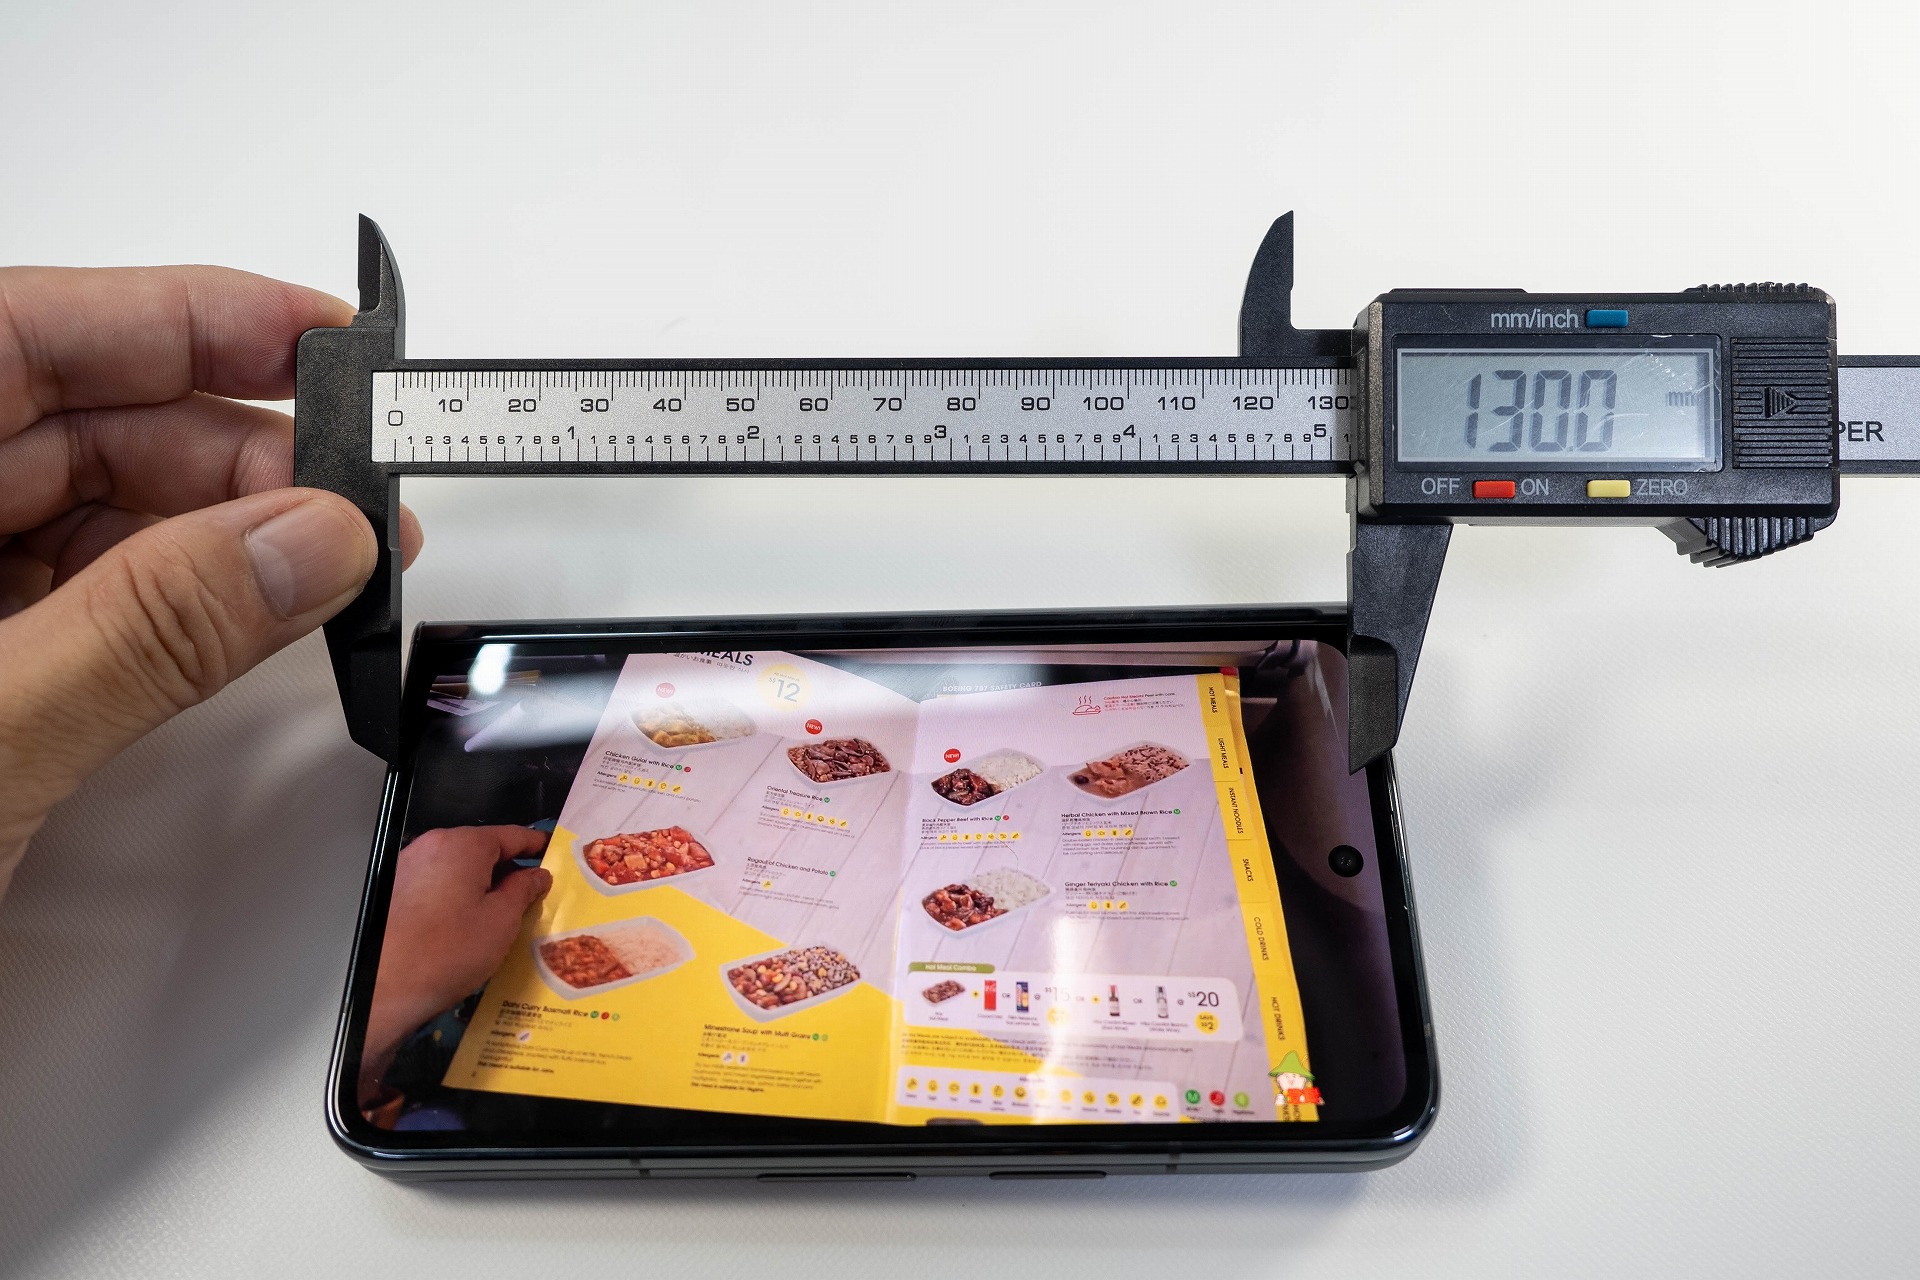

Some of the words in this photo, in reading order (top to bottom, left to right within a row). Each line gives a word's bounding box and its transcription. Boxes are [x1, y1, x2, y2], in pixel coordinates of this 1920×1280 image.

[1490, 308, 1579, 329] mm/inch
[438, 398, 463, 413] 10
[508, 398, 537, 413] 20
[581, 398, 609, 413] 30
[653, 398, 682, 412] 40
[726, 398, 755, 412] 50
[800, 398, 828, 412] 60
[873, 398, 902, 412] 70
[947, 397, 976, 412] 80
[1021, 397, 1050, 412] 90
[1083, 396, 1124, 411] 100
[1158, 396, 1195, 411] 110
[1233, 396, 1273, 411] 120
[1308, 396, 1349, 411] 130
[407, 435, 413, 445] 1
[424, 435, 434, 445] 2
[442, 435, 452, 445] 3
[460, 435, 470, 445] 4
[479, 435, 488, 445] 5
[497, 435, 506, 445] 6
[514, 435, 523, 445] 7
[532, 435, 542, 445] 8
[551, 435, 560, 445] 9
[567, 425, 575, 440] 1
[590, 435, 596, 445] 1
[608, 435, 617, 445] 2
[626, 435, 635, 445] 3
[644, 434, 654, 445] 4
[663, 434, 672, 445] 5
[681, 434, 690, 445] 6
[699, 434, 708, 445] 7
[717, 434, 727, 445] 8
[736, 434, 746, 445] 9
[746, 425, 760, 440] 2
[776, 434, 782, 444] 1
[794, 434, 803, 444] 2
[812, 434, 821, 444] 3
[830, 434, 840, 444] 4
[849, 434, 859, 444] 5
[867, 434, 877, 444] 6
[885, 434, 895, 444] 7
[904, 434, 914, 444] 8
[923, 434, 933, 444] 9
[933, 424, 947, 440] 3
[963, 434, 969, 444] 1
[981, 434, 991, 444] 2
[1000, 434, 1009, 444] 3
[1018, 433, 1028, 444] 4
[1037, 433, 1047, 444] 5
[1056, 433, 1065, 444] 6
[1074, 433, 1083, 444] 7
[1093, 433, 1102, 444] 8
[1112, 433, 1122, 444] 9
[1122, 424, 1137, 439] 4
[1152, 433, 1159, 444] 1
[1171, 433, 1180, 444] 2
[1189, 433, 1199, 444] 3
[1208, 433, 1218, 443] 4
[1227, 433, 1237, 443] 5
[1246, 433, 1255, 443] 6
[1264, 433, 1274, 443] 7
[1283, 433, 1293, 443] 8
[1302, 433, 1312, 443] 9
[1313, 423, 1327, 438] 5
[1421, 478, 1460, 496] OFF
[1521, 478, 1549, 496] ON
[1636, 478, 1689, 496] ZERO
[990, 683, 1018, 691] SAFETY
[605, 750, 630, 760] Chicken
[767, 785, 788, 794] Oriental
[789, 790, 810, 799] Treasure
[747, 857, 768, 865] Ragout
[775, 862, 798, 870] Chicken
[1242, 858, 1254, 882] SNACKS
[1254, 917, 1263, 936] COLD
[1258, 936, 1269, 961] DRINKS
